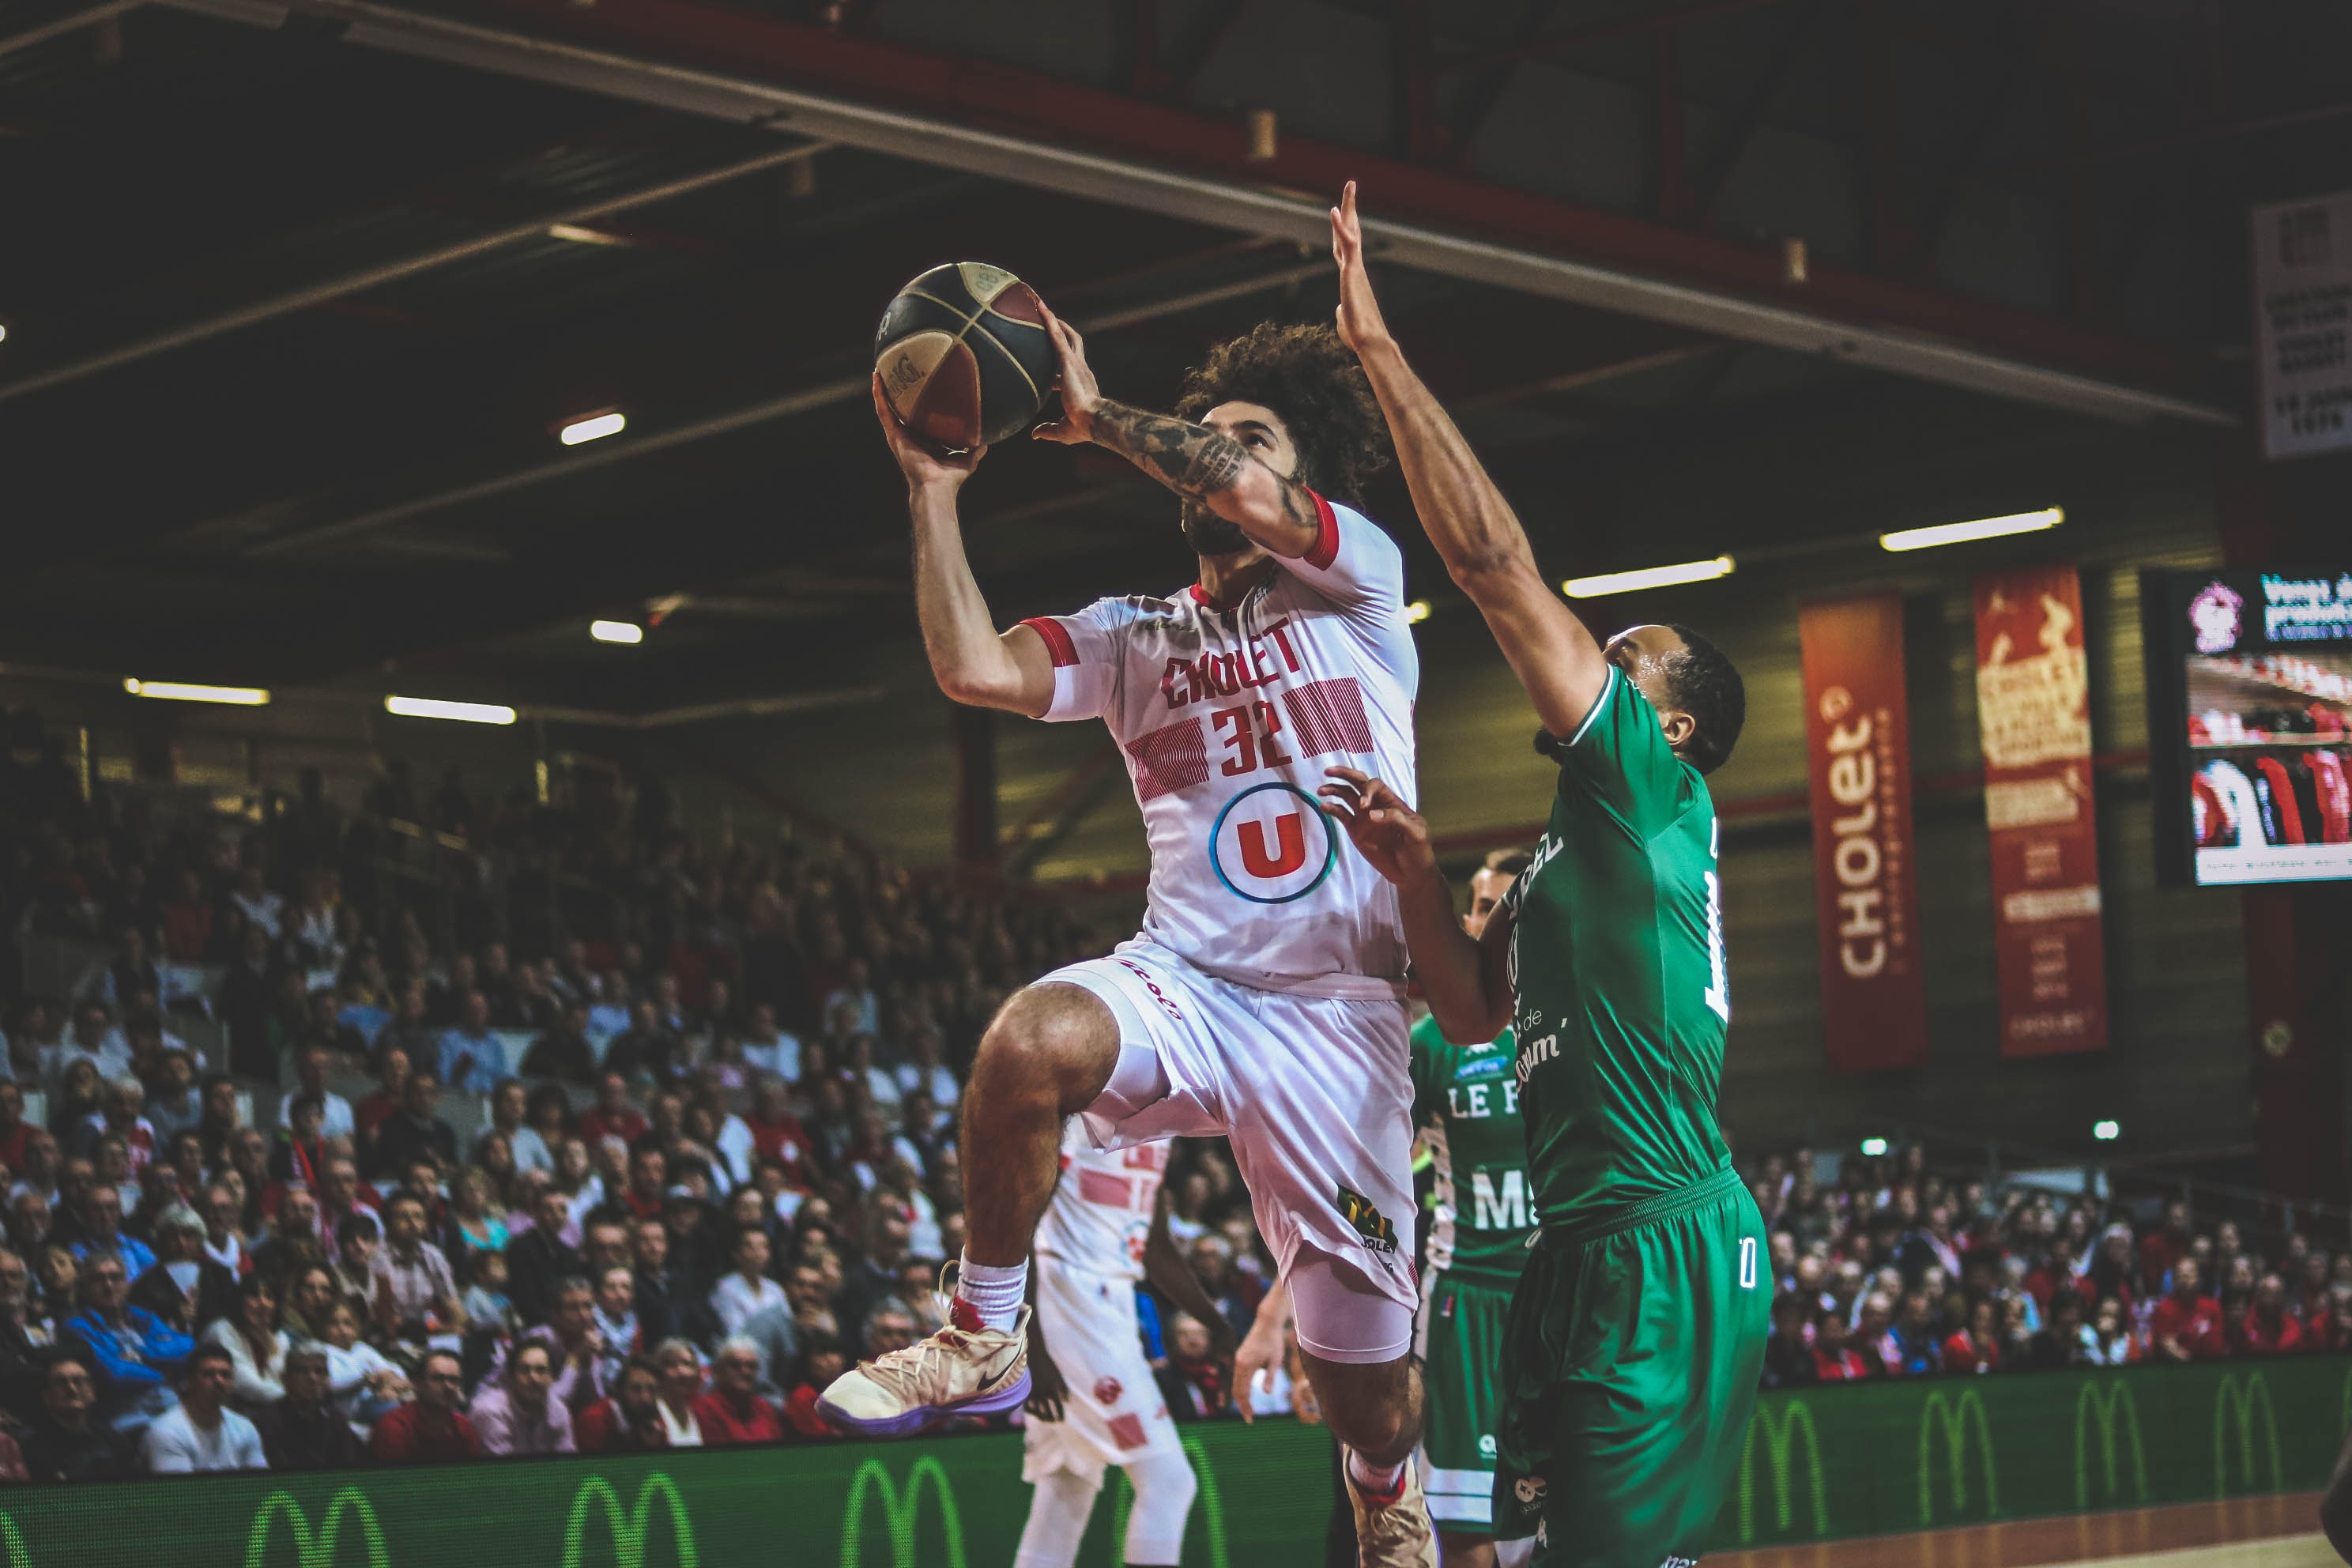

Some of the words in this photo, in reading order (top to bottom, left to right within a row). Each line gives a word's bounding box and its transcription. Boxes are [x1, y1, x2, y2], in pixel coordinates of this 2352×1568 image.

[1161, 618, 1302, 710] CHOLET
[1212, 700, 1293, 777] 32
[1236, 812, 1306, 880] U
[1522, 1008, 1543, 1031] de
[1447, 1082, 1492, 1120] LE
